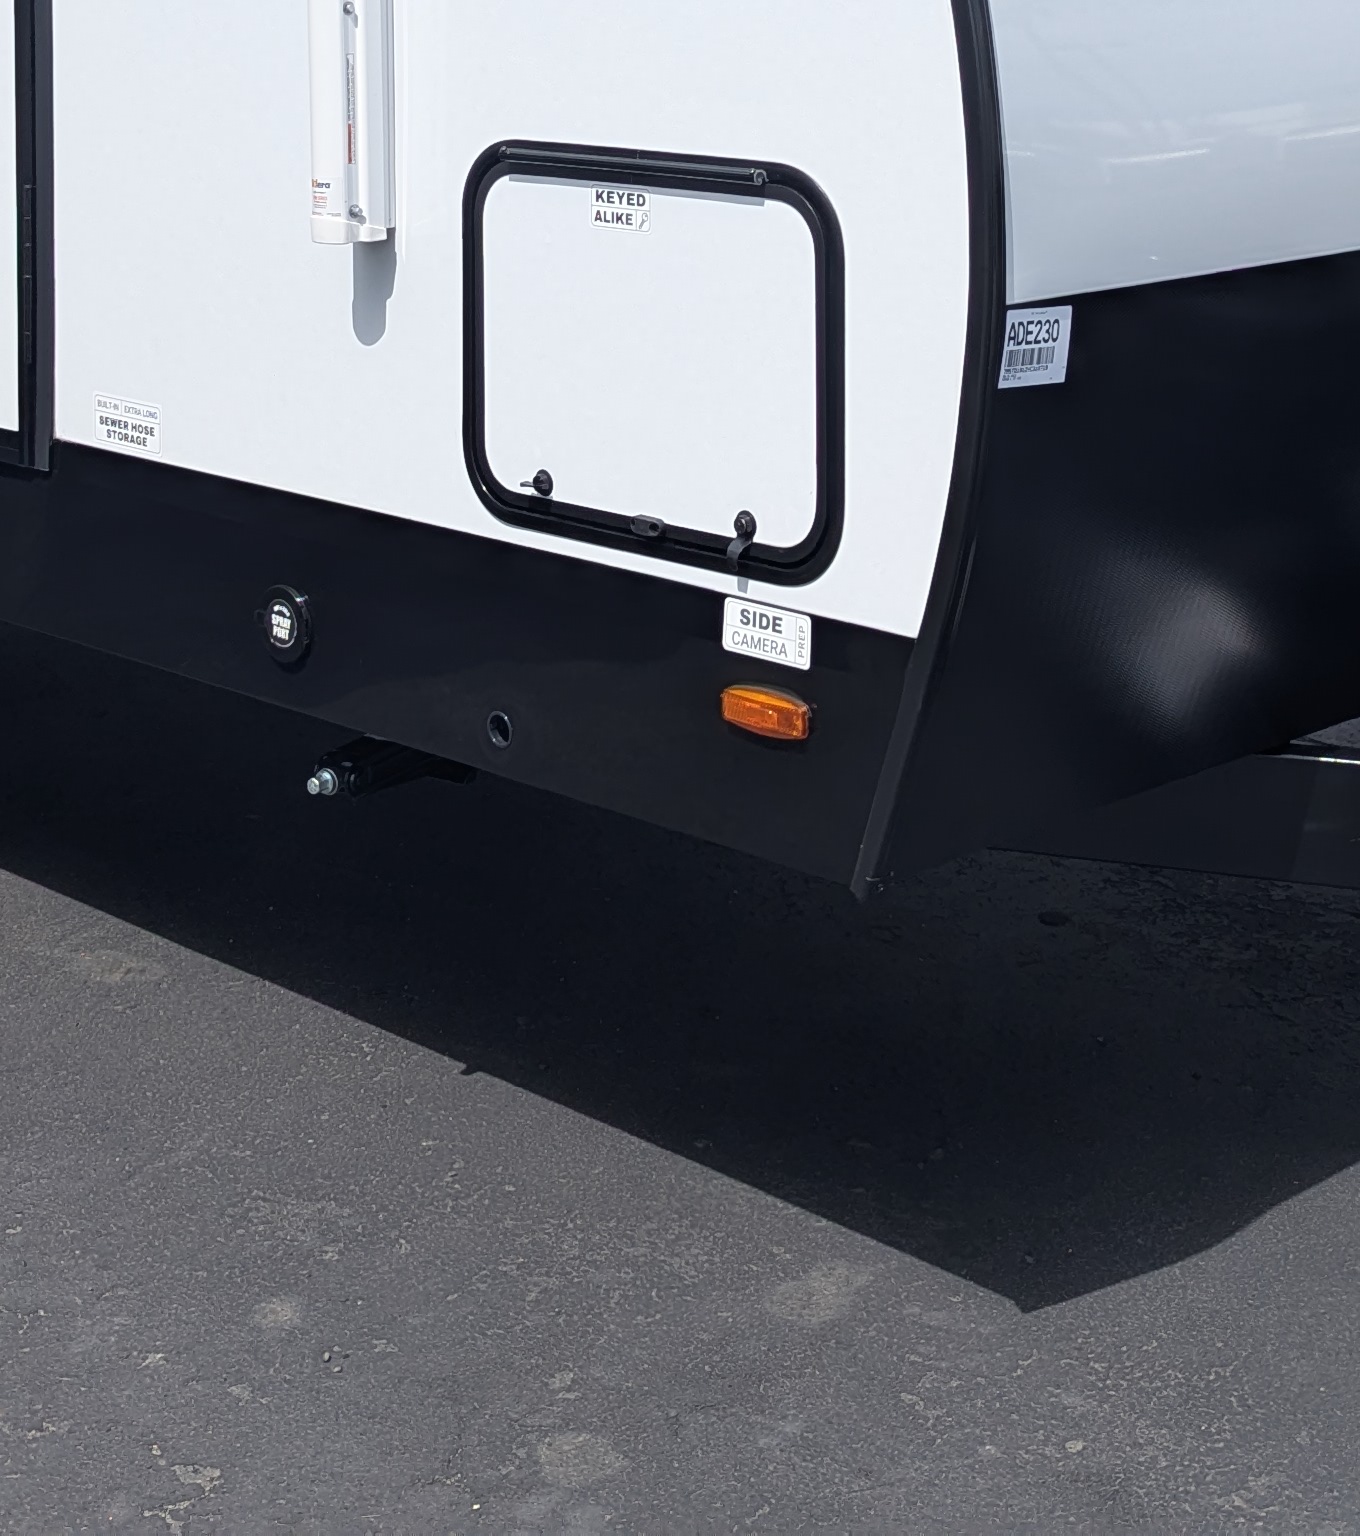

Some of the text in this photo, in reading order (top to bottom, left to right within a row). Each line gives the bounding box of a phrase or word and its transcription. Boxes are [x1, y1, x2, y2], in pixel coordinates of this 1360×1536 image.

[595, 189, 646, 207] KEYED
[594, 209, 633, 226] ALIKE
[1007, 318, 1060, 347] ADE230
[124, 405, 142, 416] EXTRA
[99, 415, 156, 437] SEWER HOSE
[106, 428, 148, 447] STORAGE
[739, 608, 783, 634] SIDE
[731, 630, 788, 658] CAMERA
[797, 625, 806, 658] PREP
